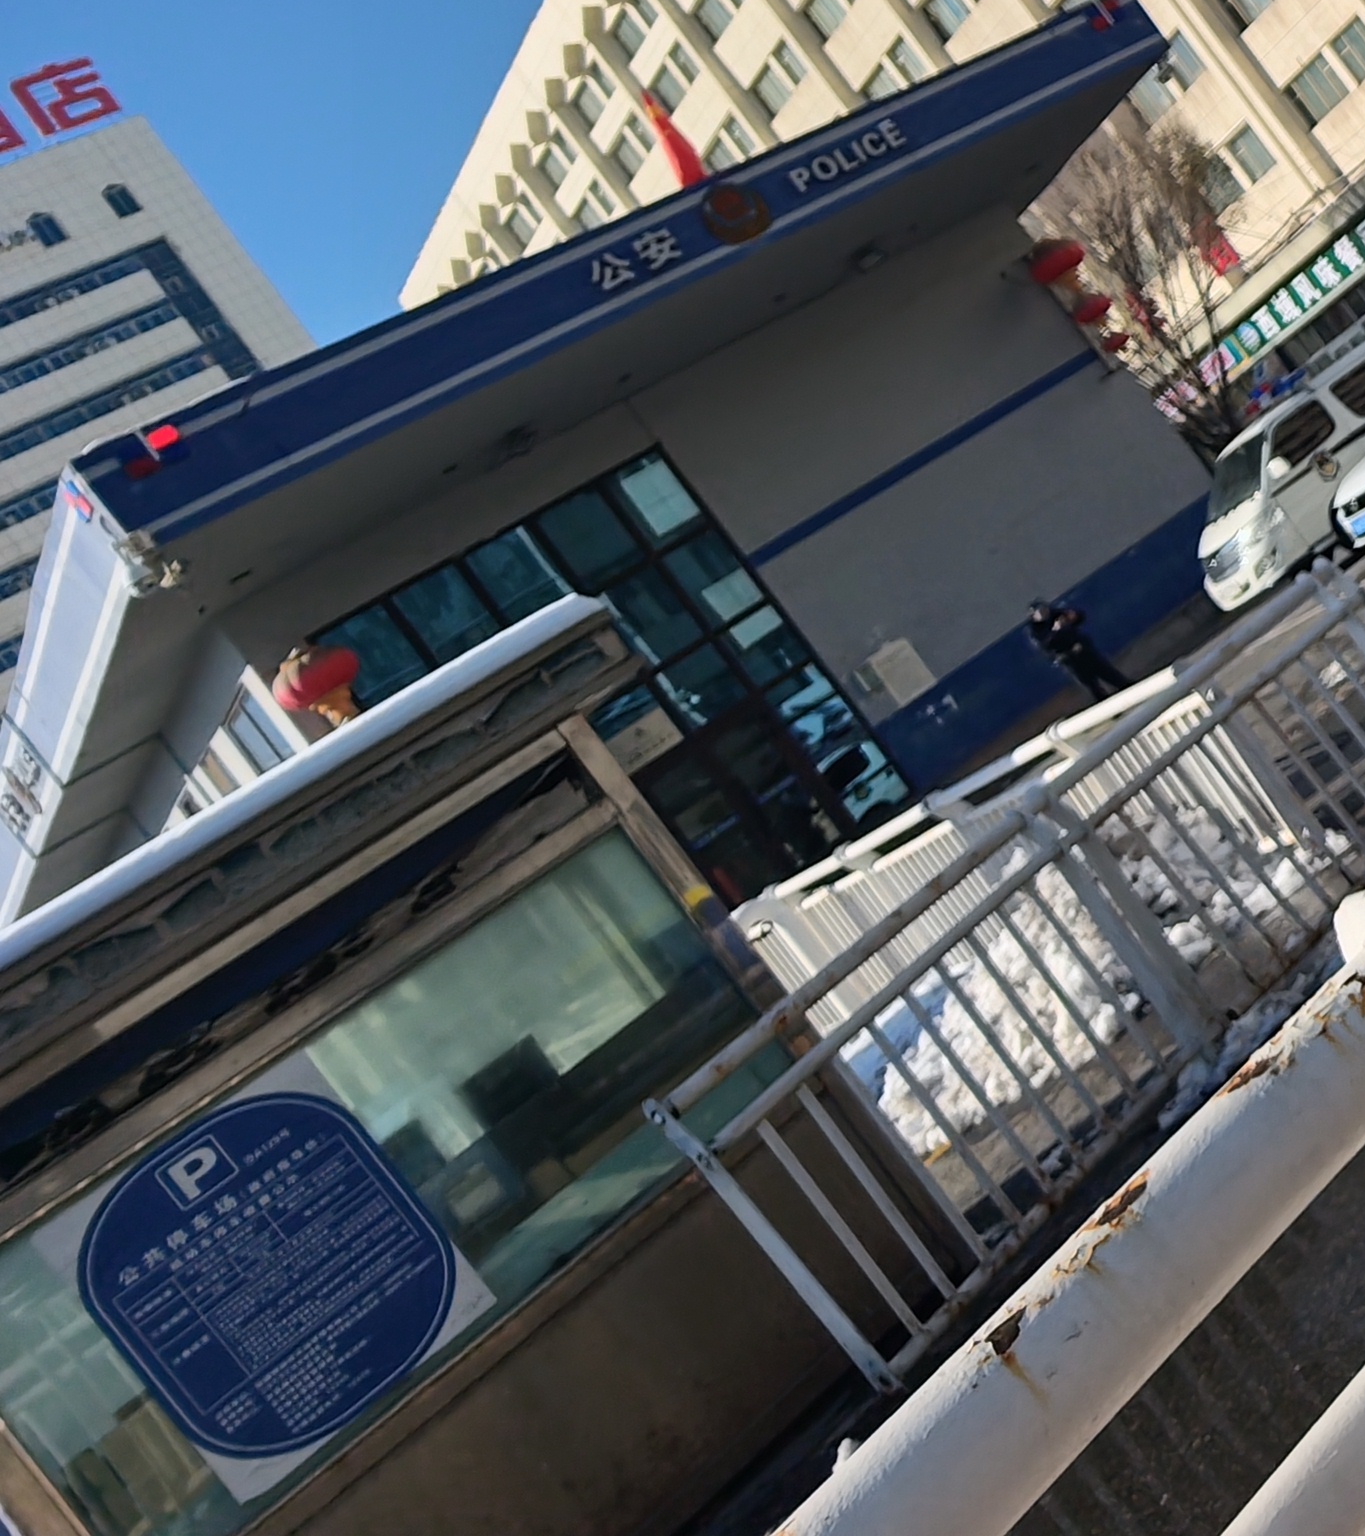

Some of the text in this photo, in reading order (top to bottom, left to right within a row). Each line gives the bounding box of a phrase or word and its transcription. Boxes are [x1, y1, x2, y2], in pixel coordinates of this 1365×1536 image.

[0, 55, 123, 154] 店
[787, 117, 908, 194] POLICE
[591, 228, 683, 291] 公安
[168, 1145, 218, 1197] P
[119, 1195, 238, 1284] 公共停车场
